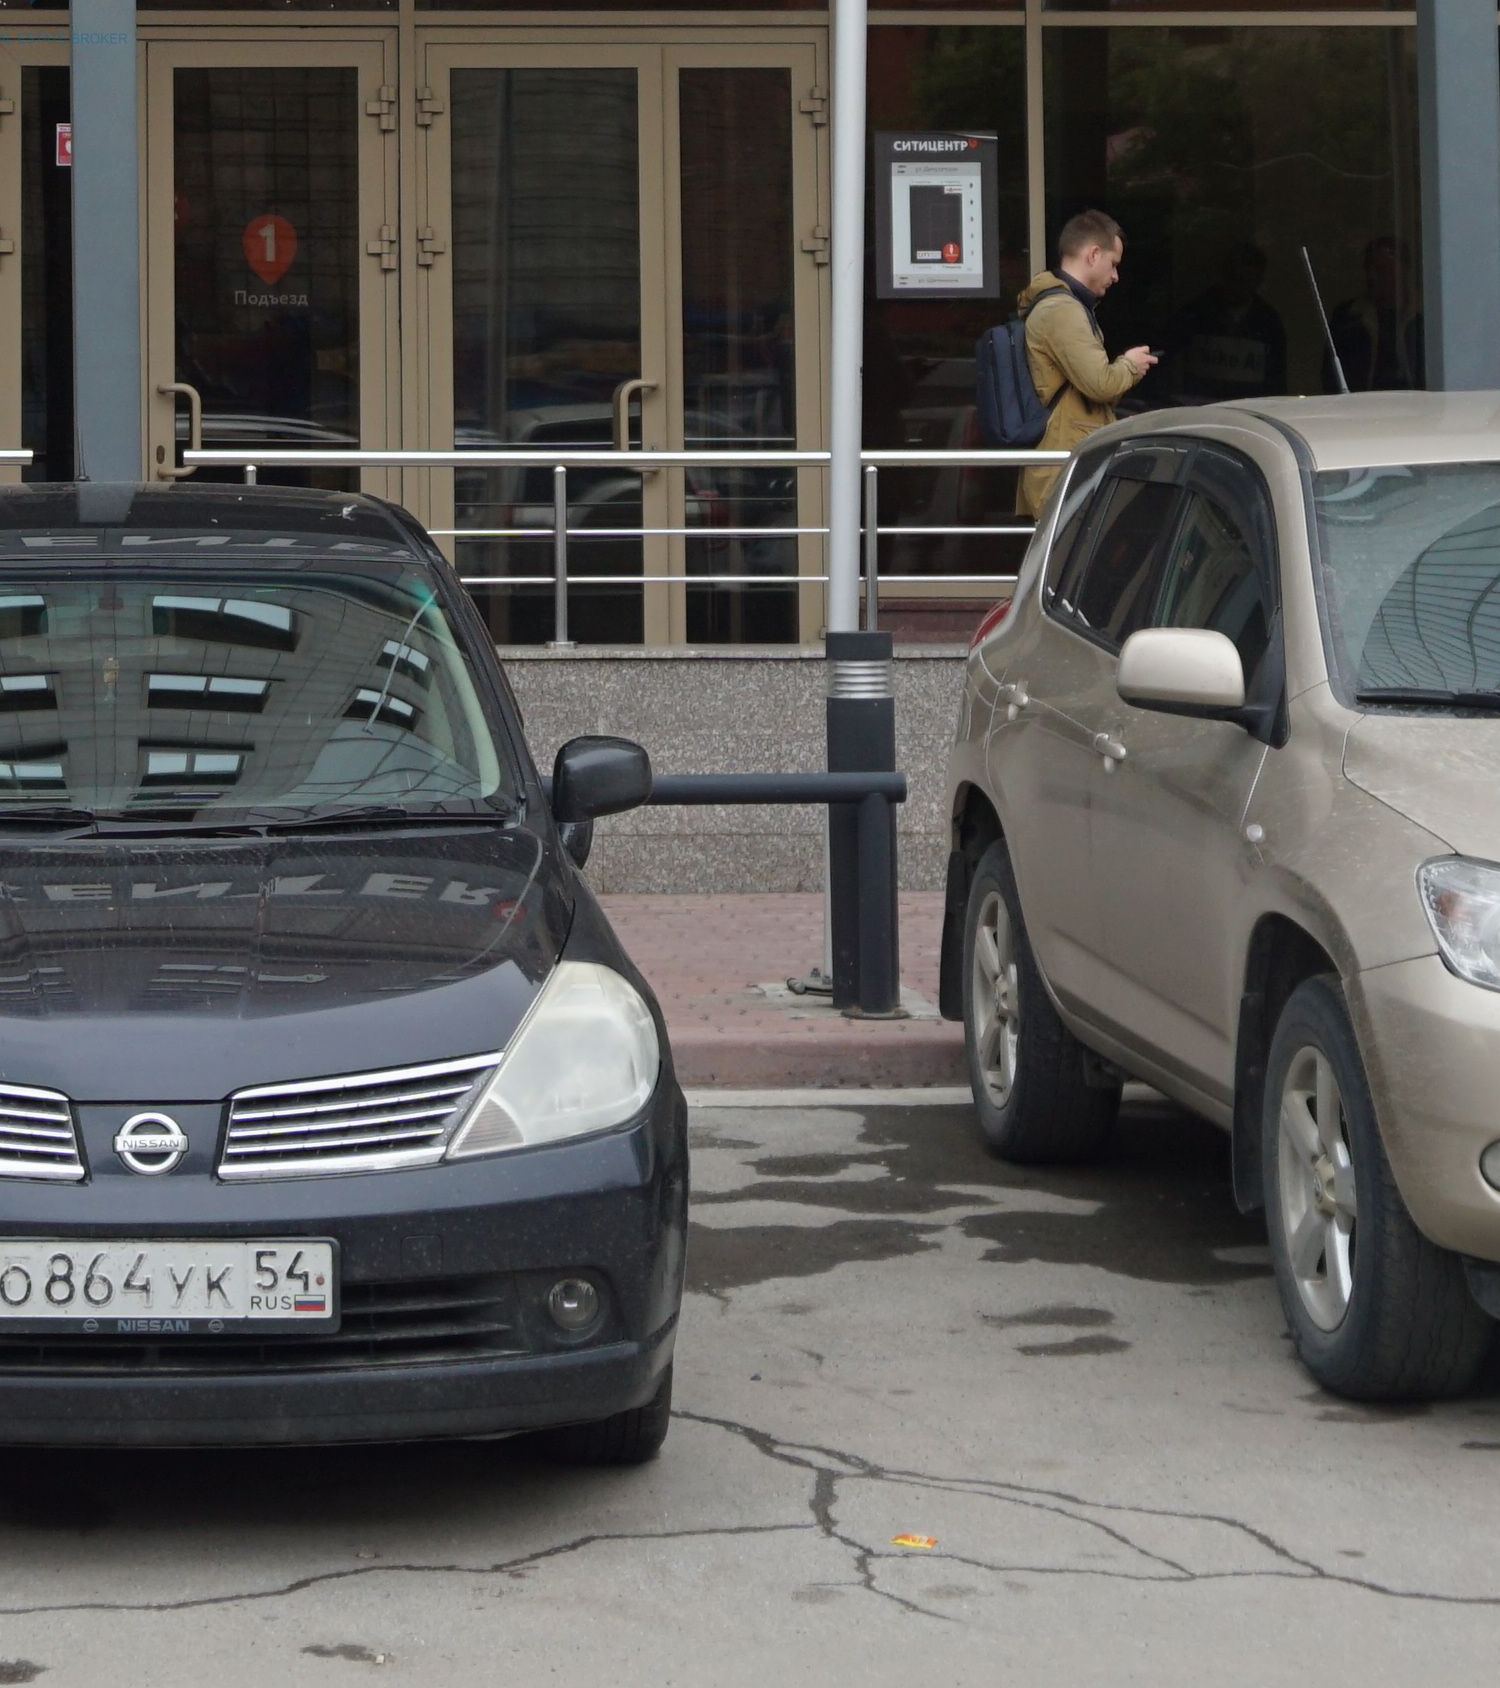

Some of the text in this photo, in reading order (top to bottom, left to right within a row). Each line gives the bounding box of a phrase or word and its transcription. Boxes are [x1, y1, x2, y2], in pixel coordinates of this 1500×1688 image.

[893, 140, 969, 152] СИТИЦЕНТР
[257, 223, 277, 262] 1
[234, 290, 309, 307] Подъезд
[122, 1138, 180, 1150] NISSAN
[255, 1249, 311, 1293] 54
[250, 1296, 293, 1310] RUS
[117, 1319, 190, 1333] NISSAN
